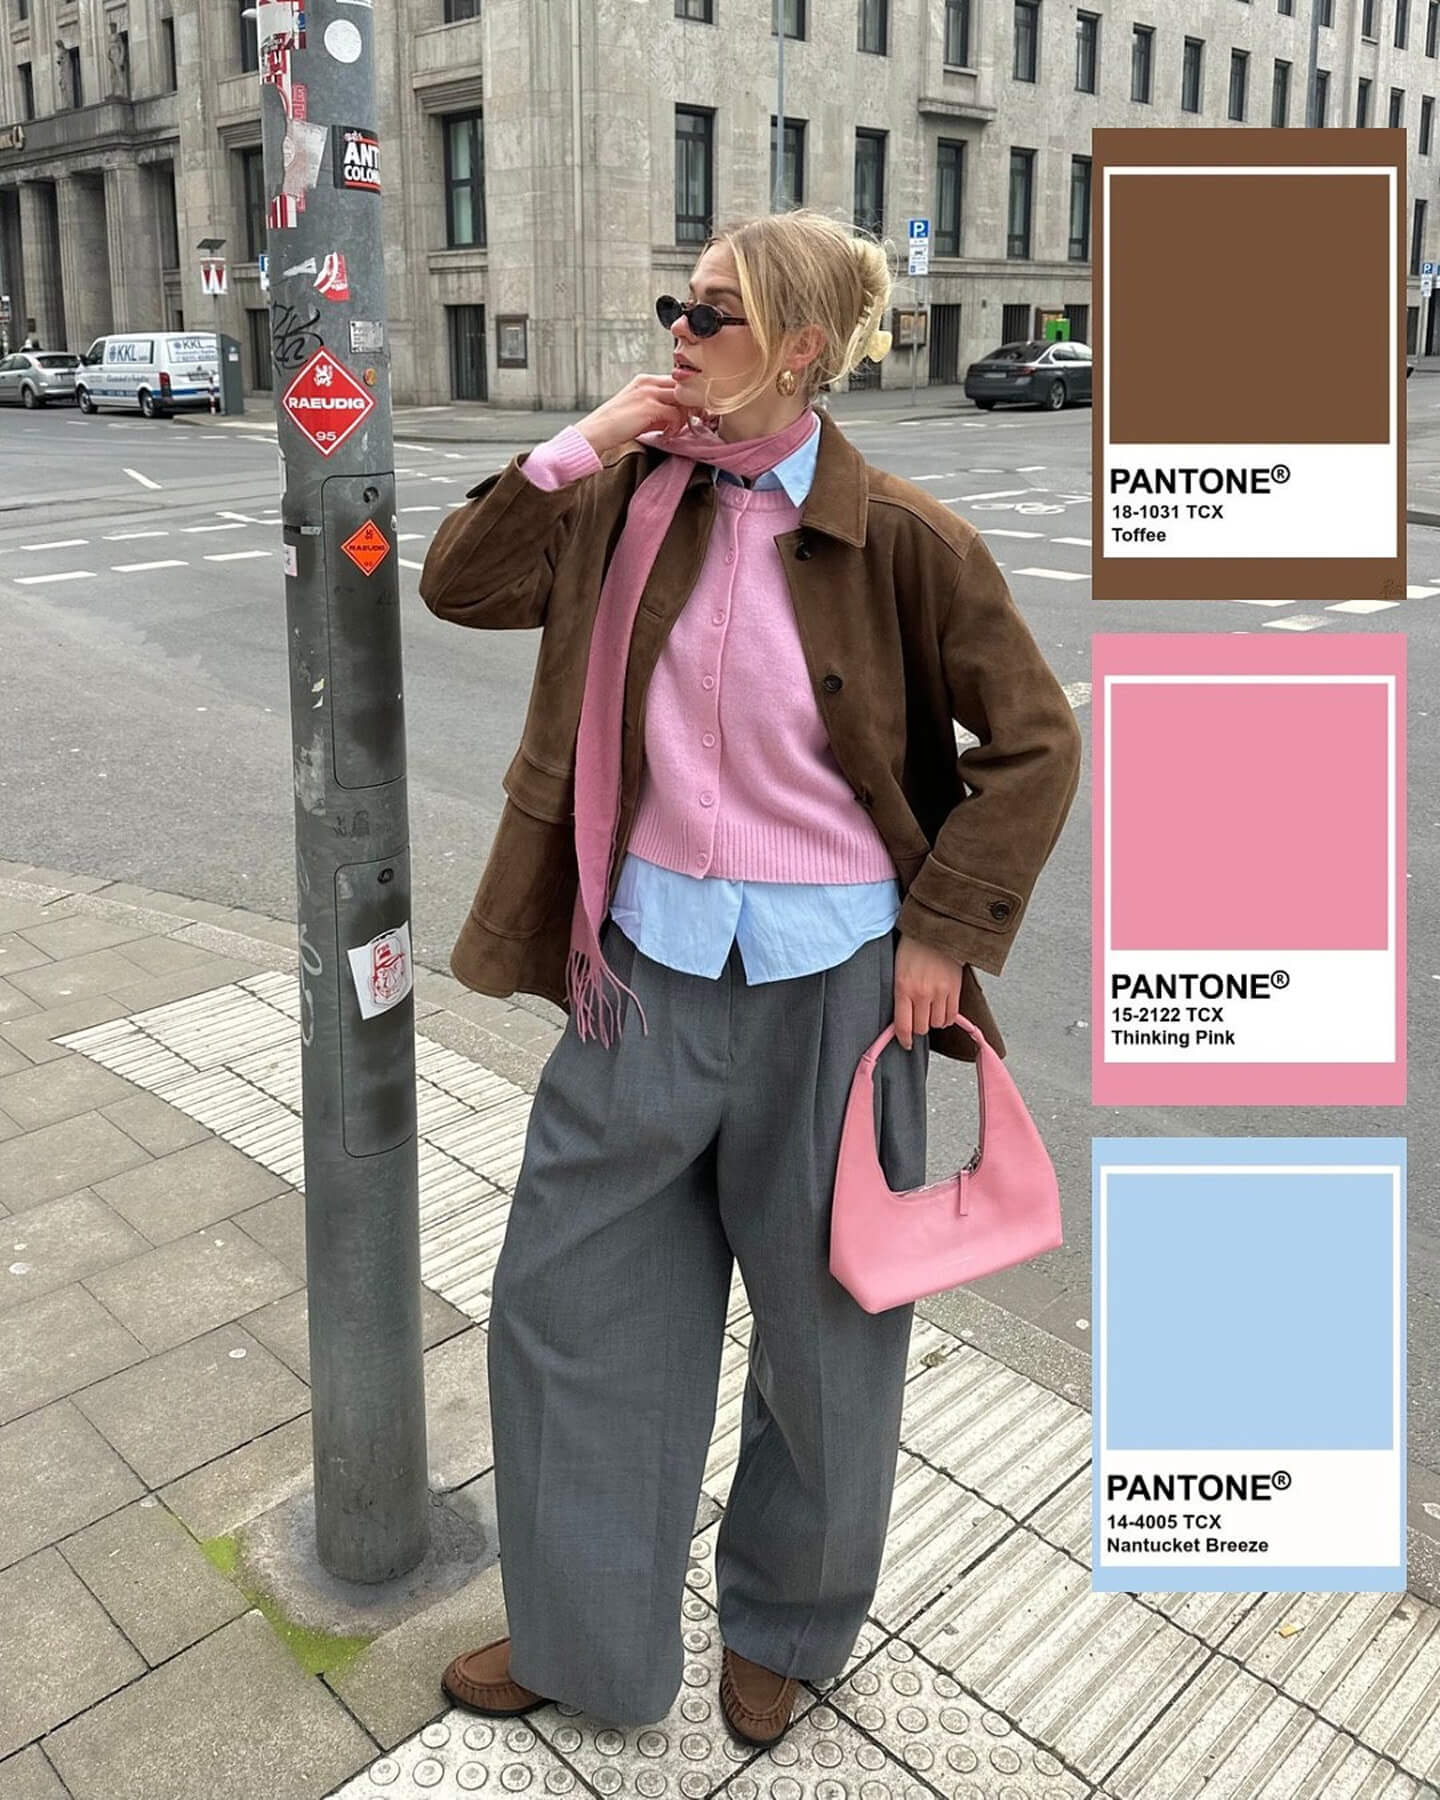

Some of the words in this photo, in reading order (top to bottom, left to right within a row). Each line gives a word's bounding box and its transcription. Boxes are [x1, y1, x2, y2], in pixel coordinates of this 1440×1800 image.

[913, 221, 926, 238] P
[117, 343, 137, 361] KKL
[288, 397, 366, 410] RAEUDIG
[315, 432, 337, 441] 95
